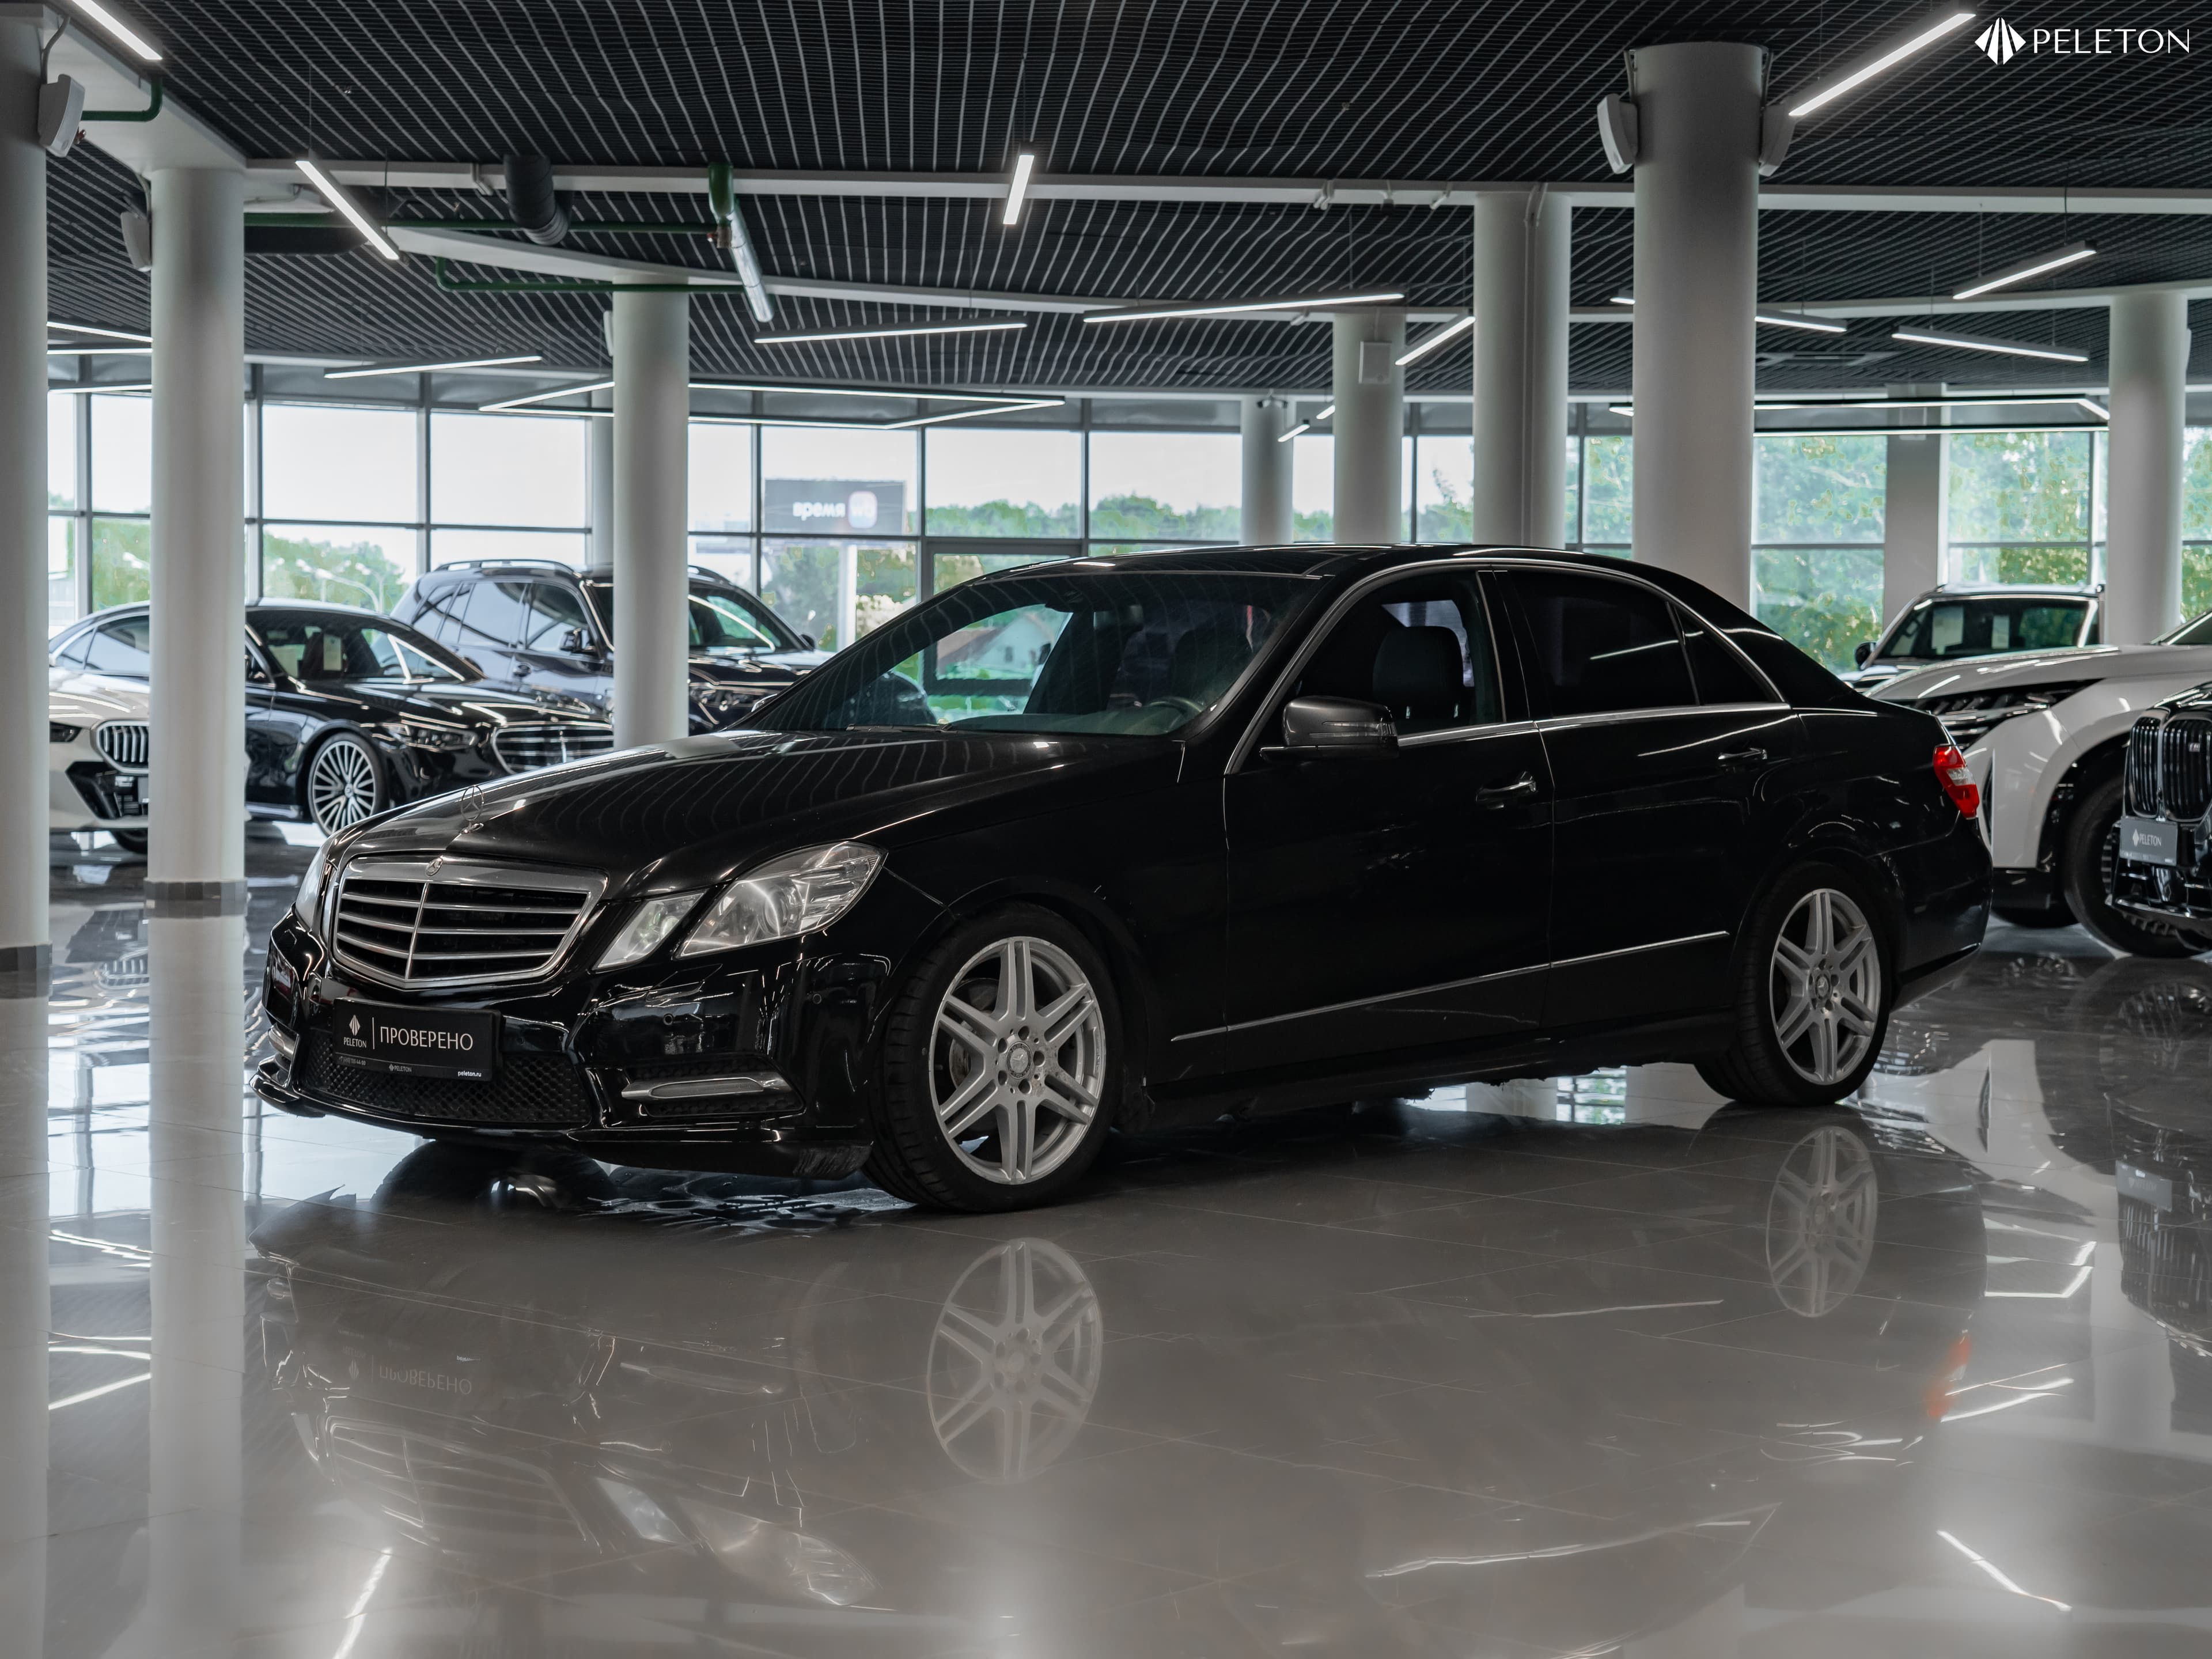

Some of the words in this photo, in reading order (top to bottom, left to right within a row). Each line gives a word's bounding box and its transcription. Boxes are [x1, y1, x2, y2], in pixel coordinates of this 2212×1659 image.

[2139, 833, 2161, 847] PELETON
[343, 1036, 367, 1048] PELETON
[380, 1026, 474, 1051] ПРОВЕРЕНО
